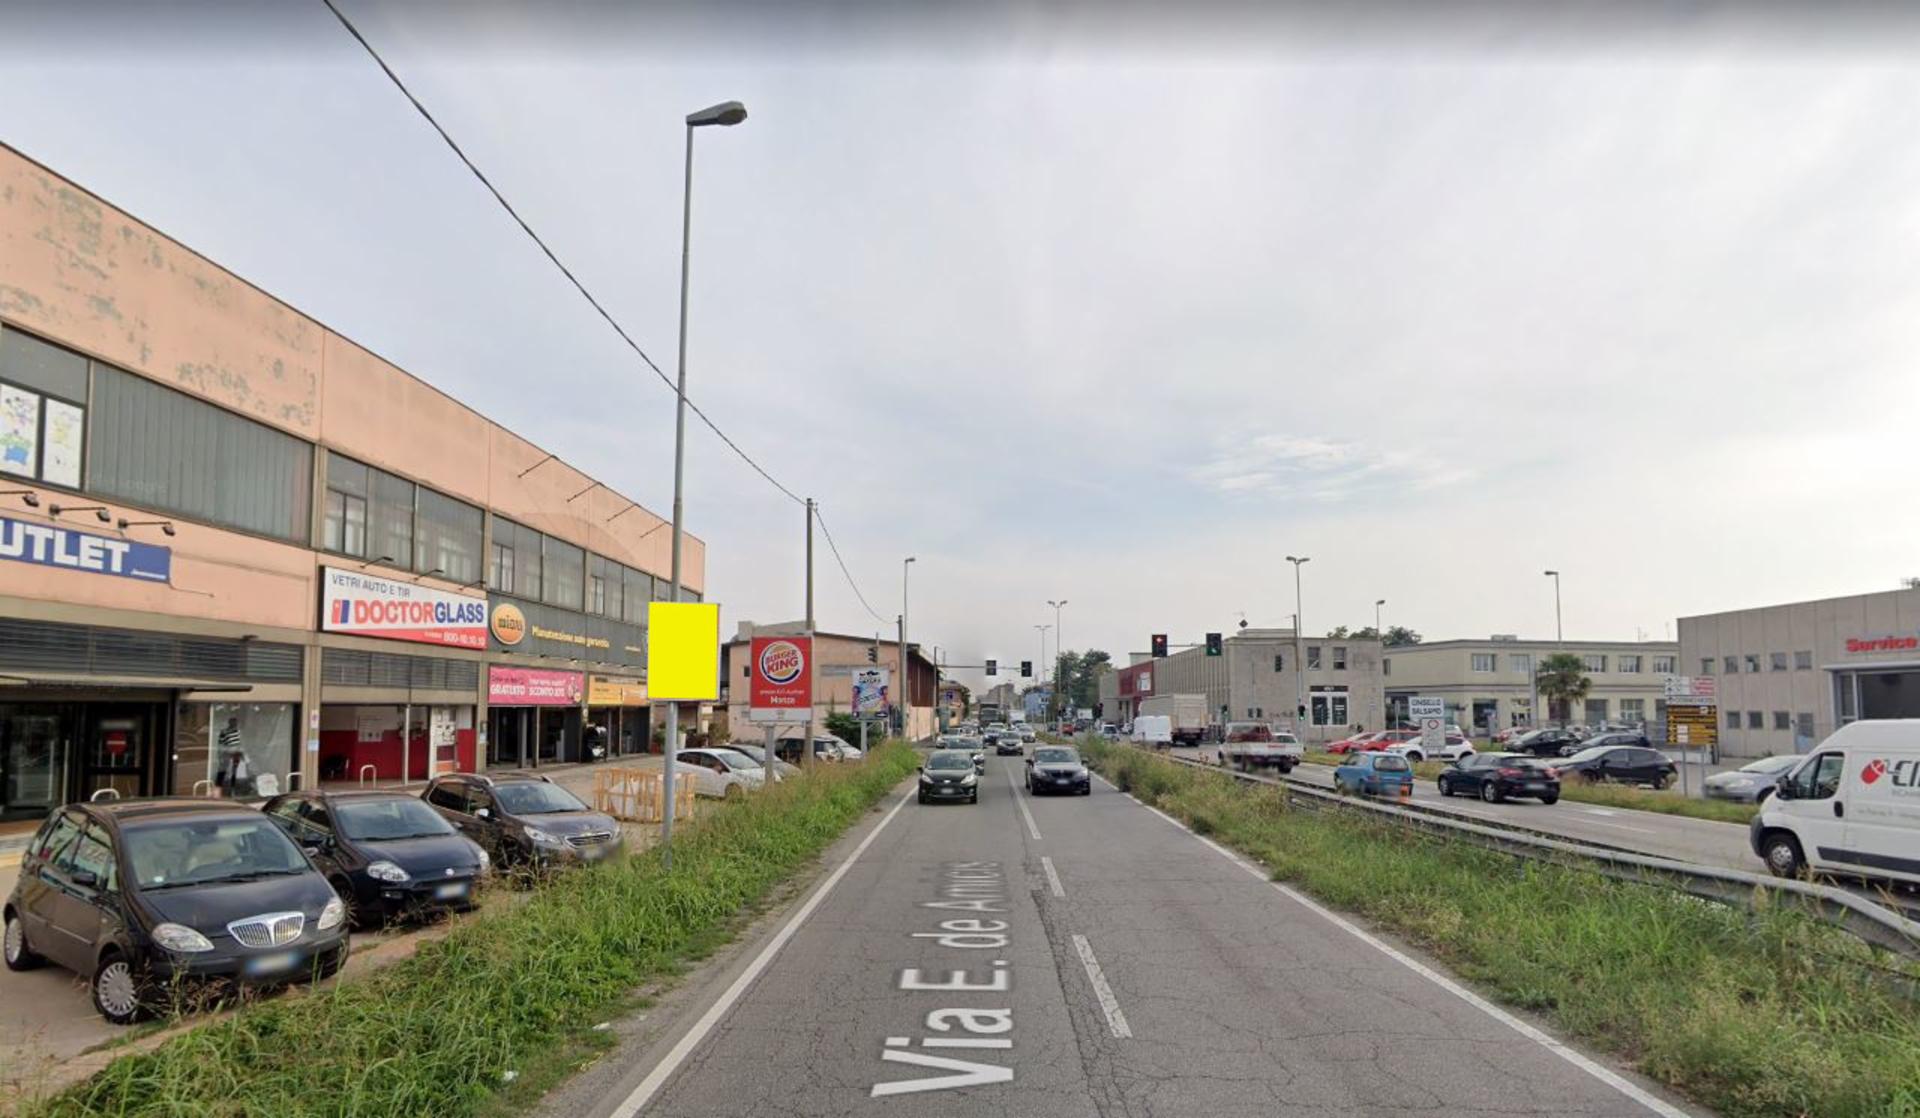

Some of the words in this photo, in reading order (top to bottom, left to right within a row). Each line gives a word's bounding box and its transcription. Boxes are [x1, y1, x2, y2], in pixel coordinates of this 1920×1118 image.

[332, 574, 361, 588] VETRI
[362, 580, 387, 594] AUTO
[389, 585, 395, 595] E
[398, 587, 410, 596] TIR
[354, 600, 484, 624] DOCTORGLASS
[1846, 636, 1917, 653] Service
[765, 649, 797, 664] BURGER
[767, 656, 799, 673] KING
